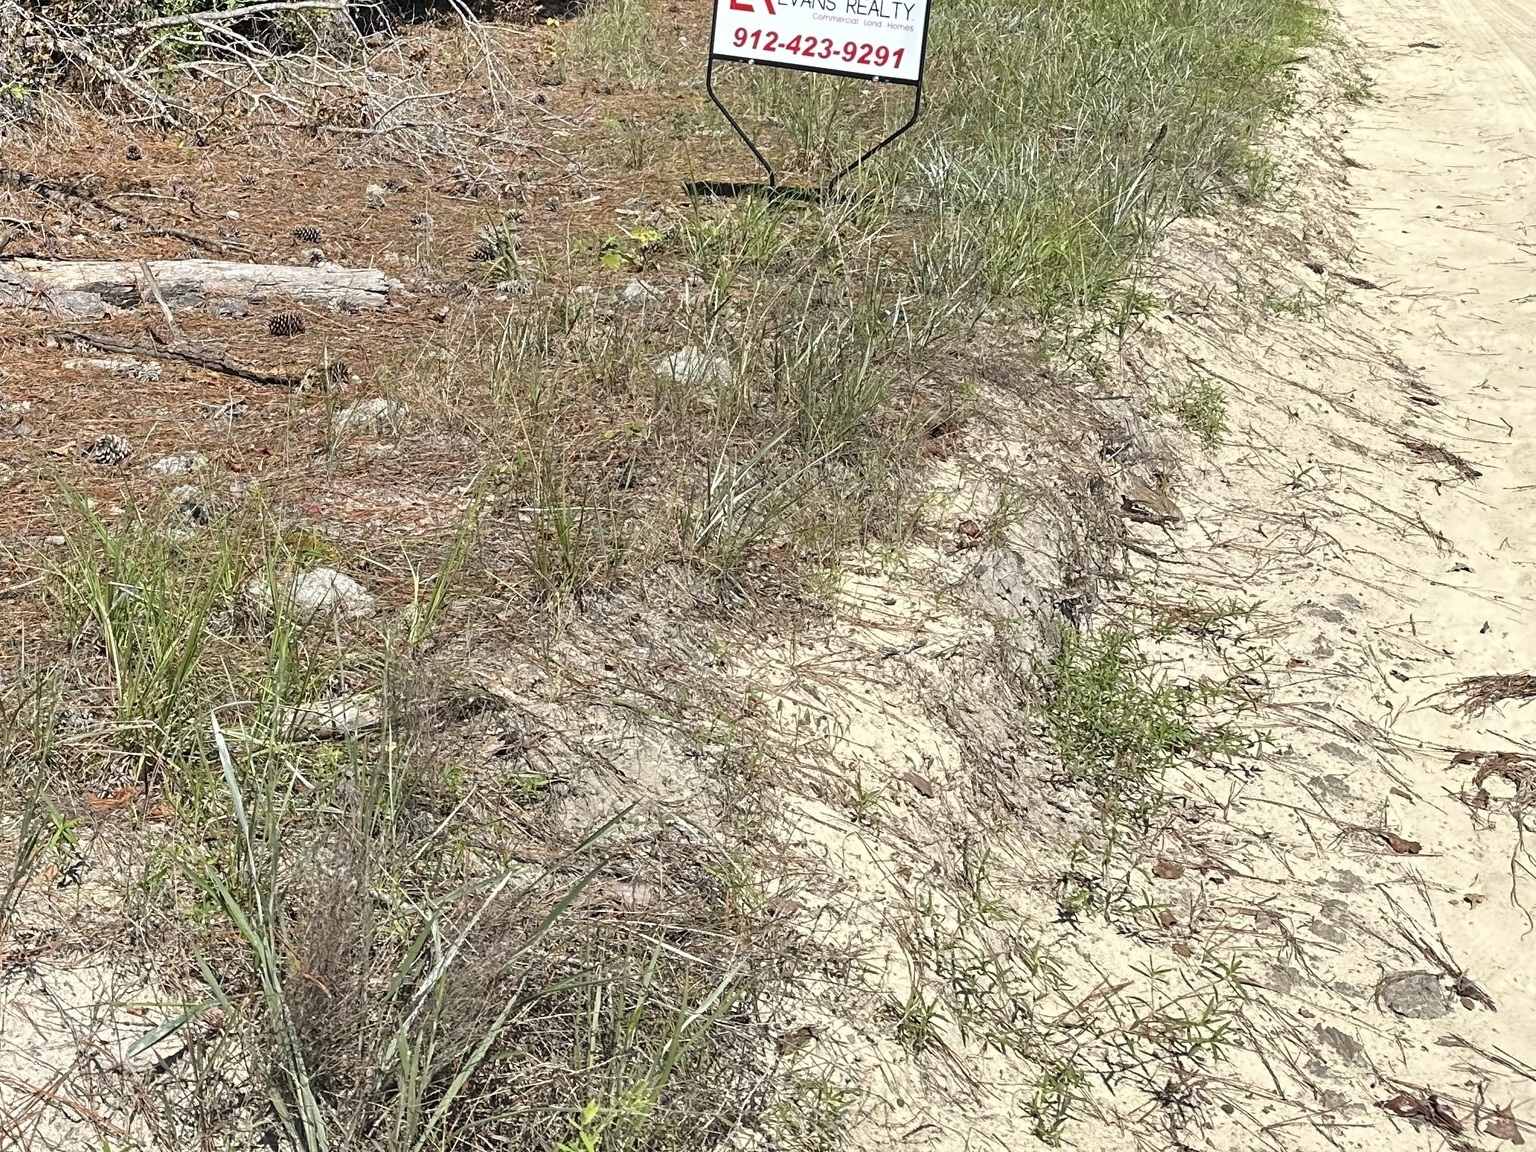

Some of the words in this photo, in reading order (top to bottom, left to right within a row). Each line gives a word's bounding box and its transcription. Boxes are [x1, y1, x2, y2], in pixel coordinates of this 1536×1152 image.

[812, 12, 859, 25] Commercial
[887, 21, 914, 32] Homes
[732, 27, 905, 69] 912-423-9291
